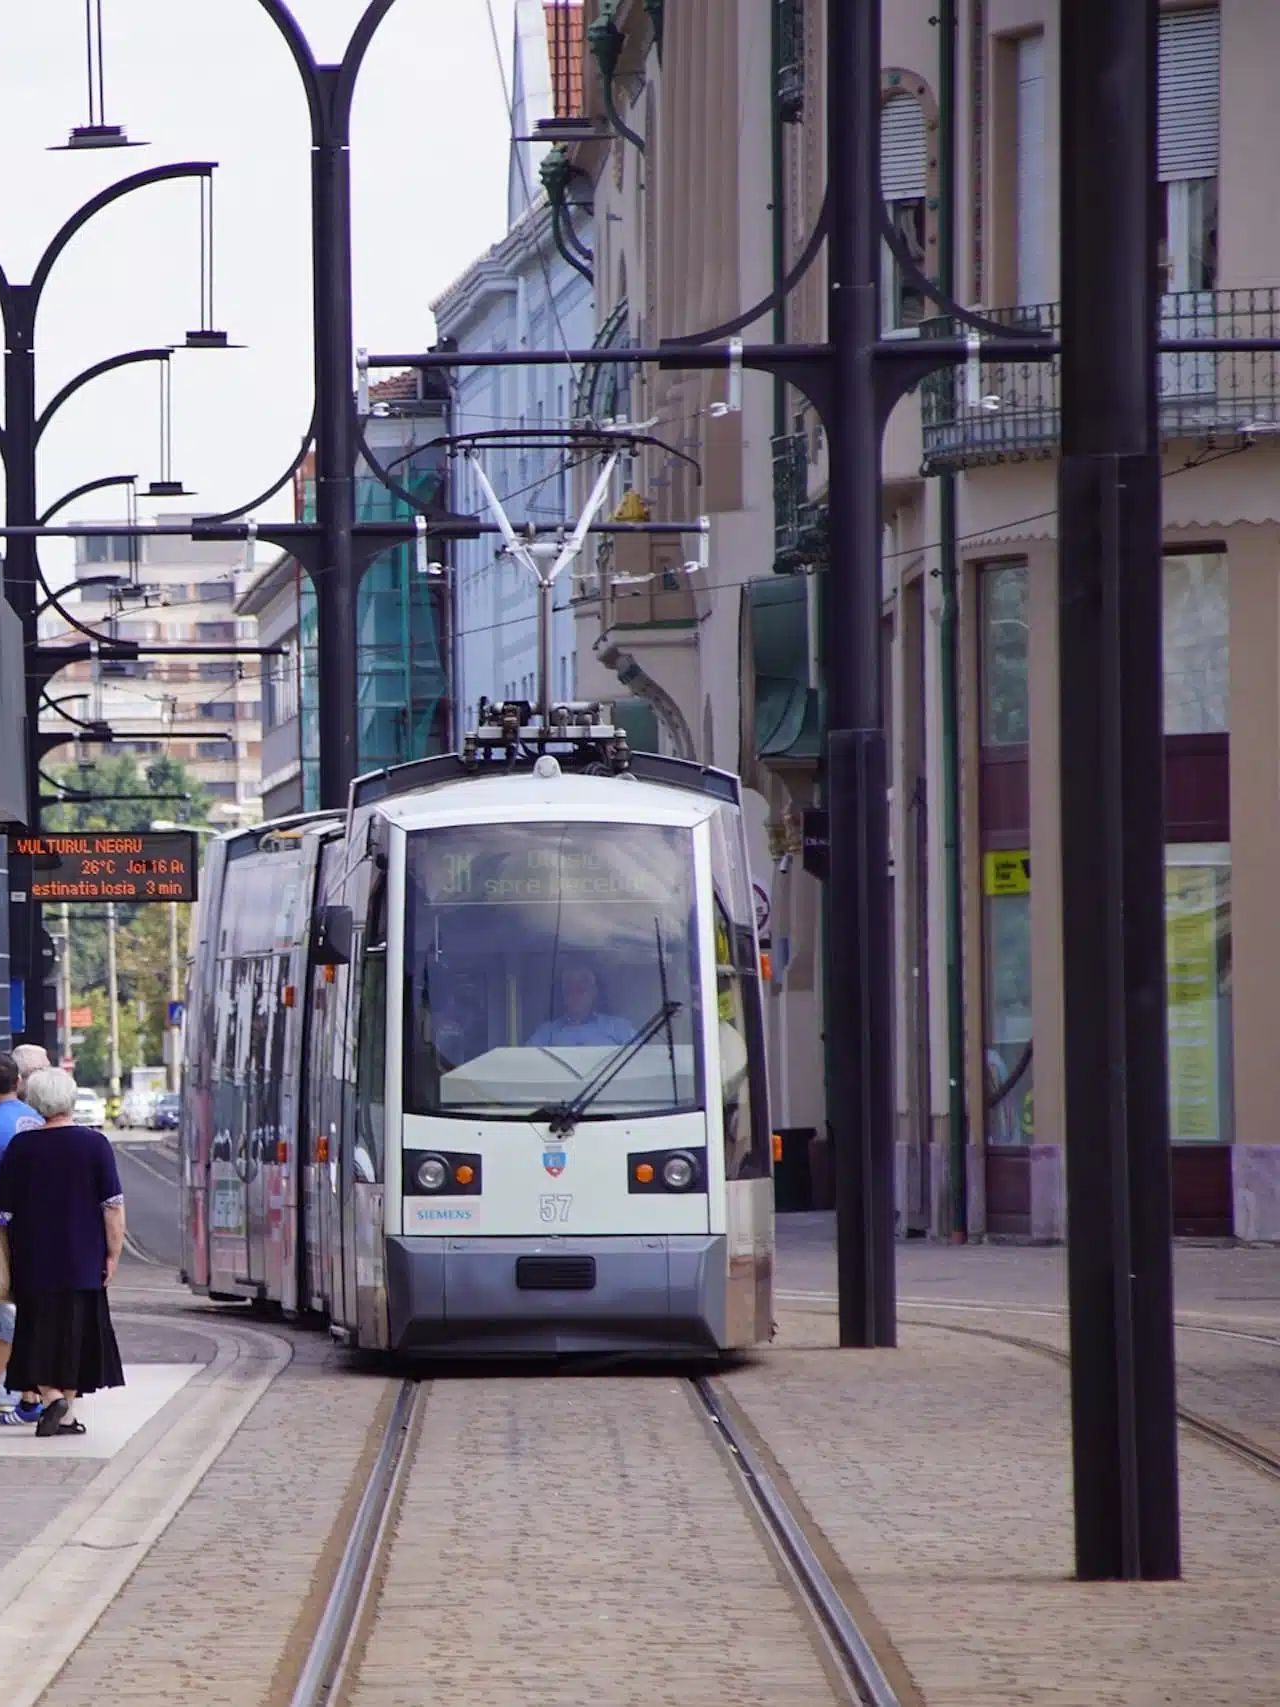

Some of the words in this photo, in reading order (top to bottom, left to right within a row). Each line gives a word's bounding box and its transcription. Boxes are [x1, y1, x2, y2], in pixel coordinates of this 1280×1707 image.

[16, 838, 92, 855] VULTURUL
[95, 838, 144, 854] NEGRU
[126, 859, 147, 875] Joi
[151, 859, 168, 875] 16
[145, 880, 156, 896] 3
[158, 880, 183, 895] min
[416, 1209, 472, 1221] SIEMENS
[539, 1193, 574, 1223] 57
